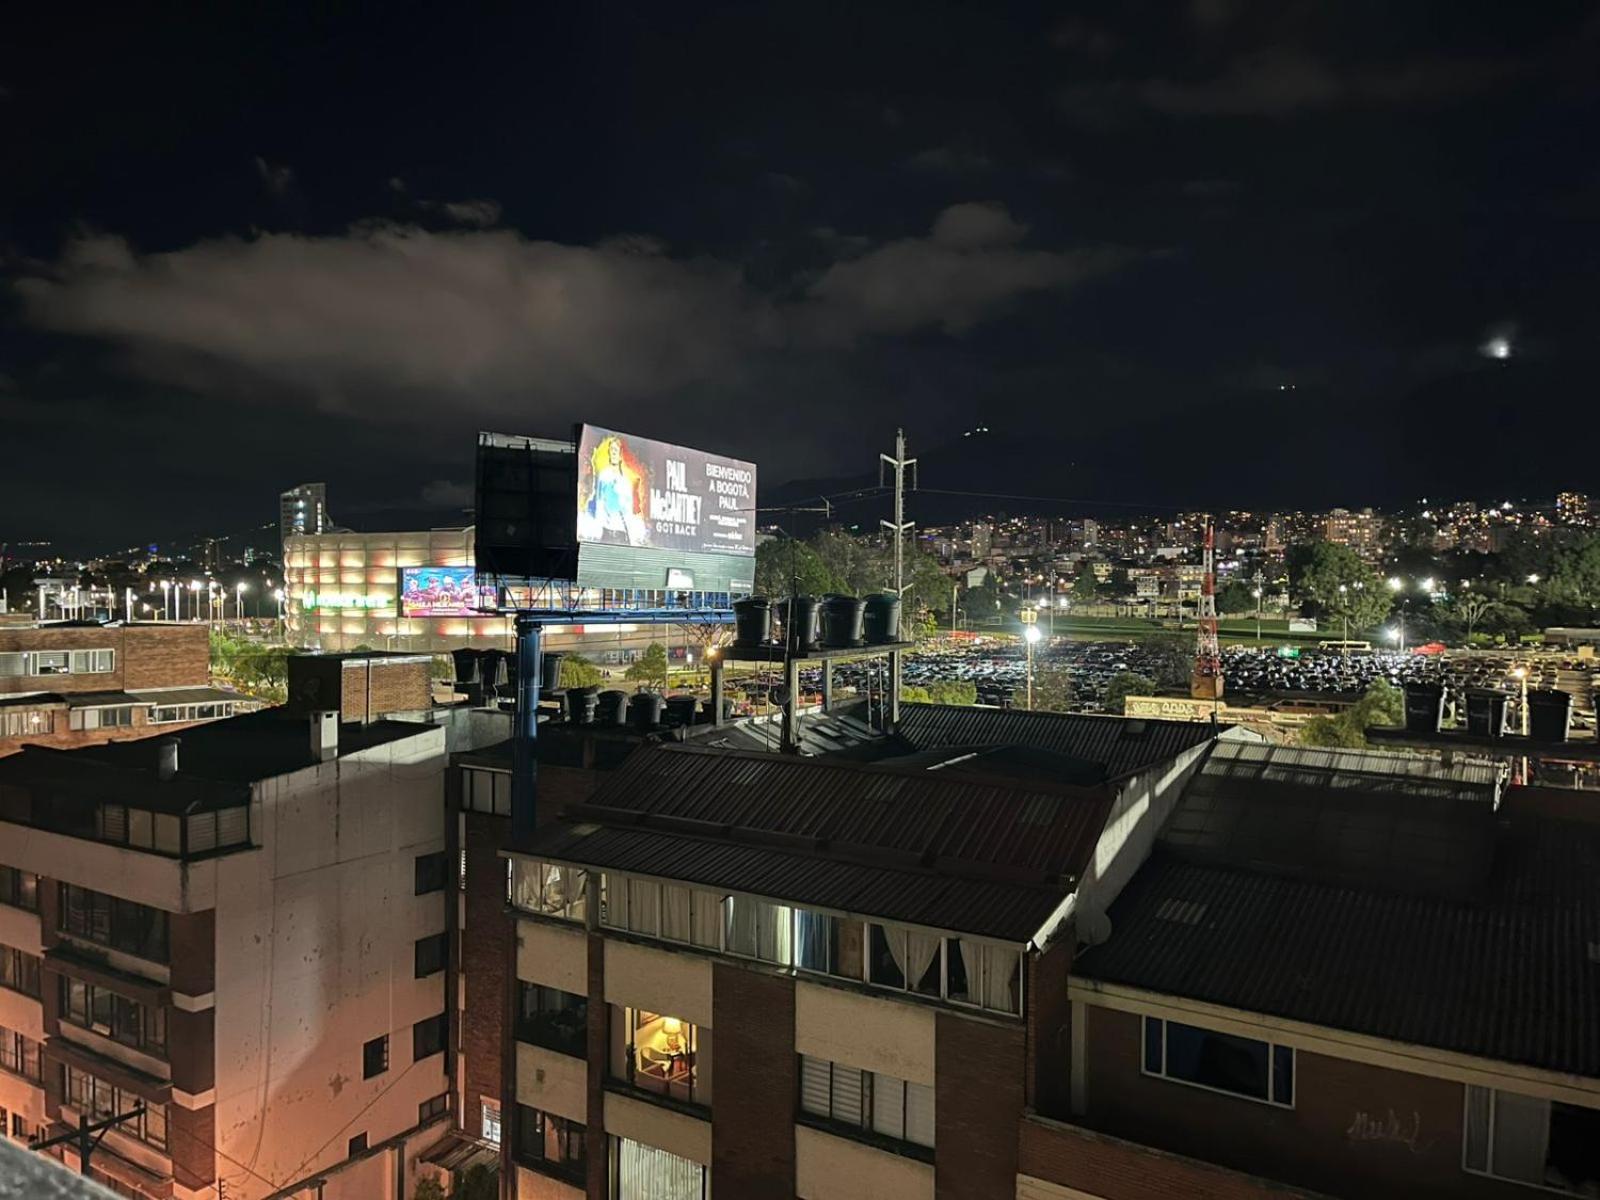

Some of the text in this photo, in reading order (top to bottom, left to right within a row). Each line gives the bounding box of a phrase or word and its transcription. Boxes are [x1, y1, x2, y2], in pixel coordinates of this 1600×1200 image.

[666, 460, 687, 492] PAUL
[706, 463, 751, 484] BIENVENIDO
[709, 480, 715, 493] A
[656, 522, 697, 536] GOT BACK
